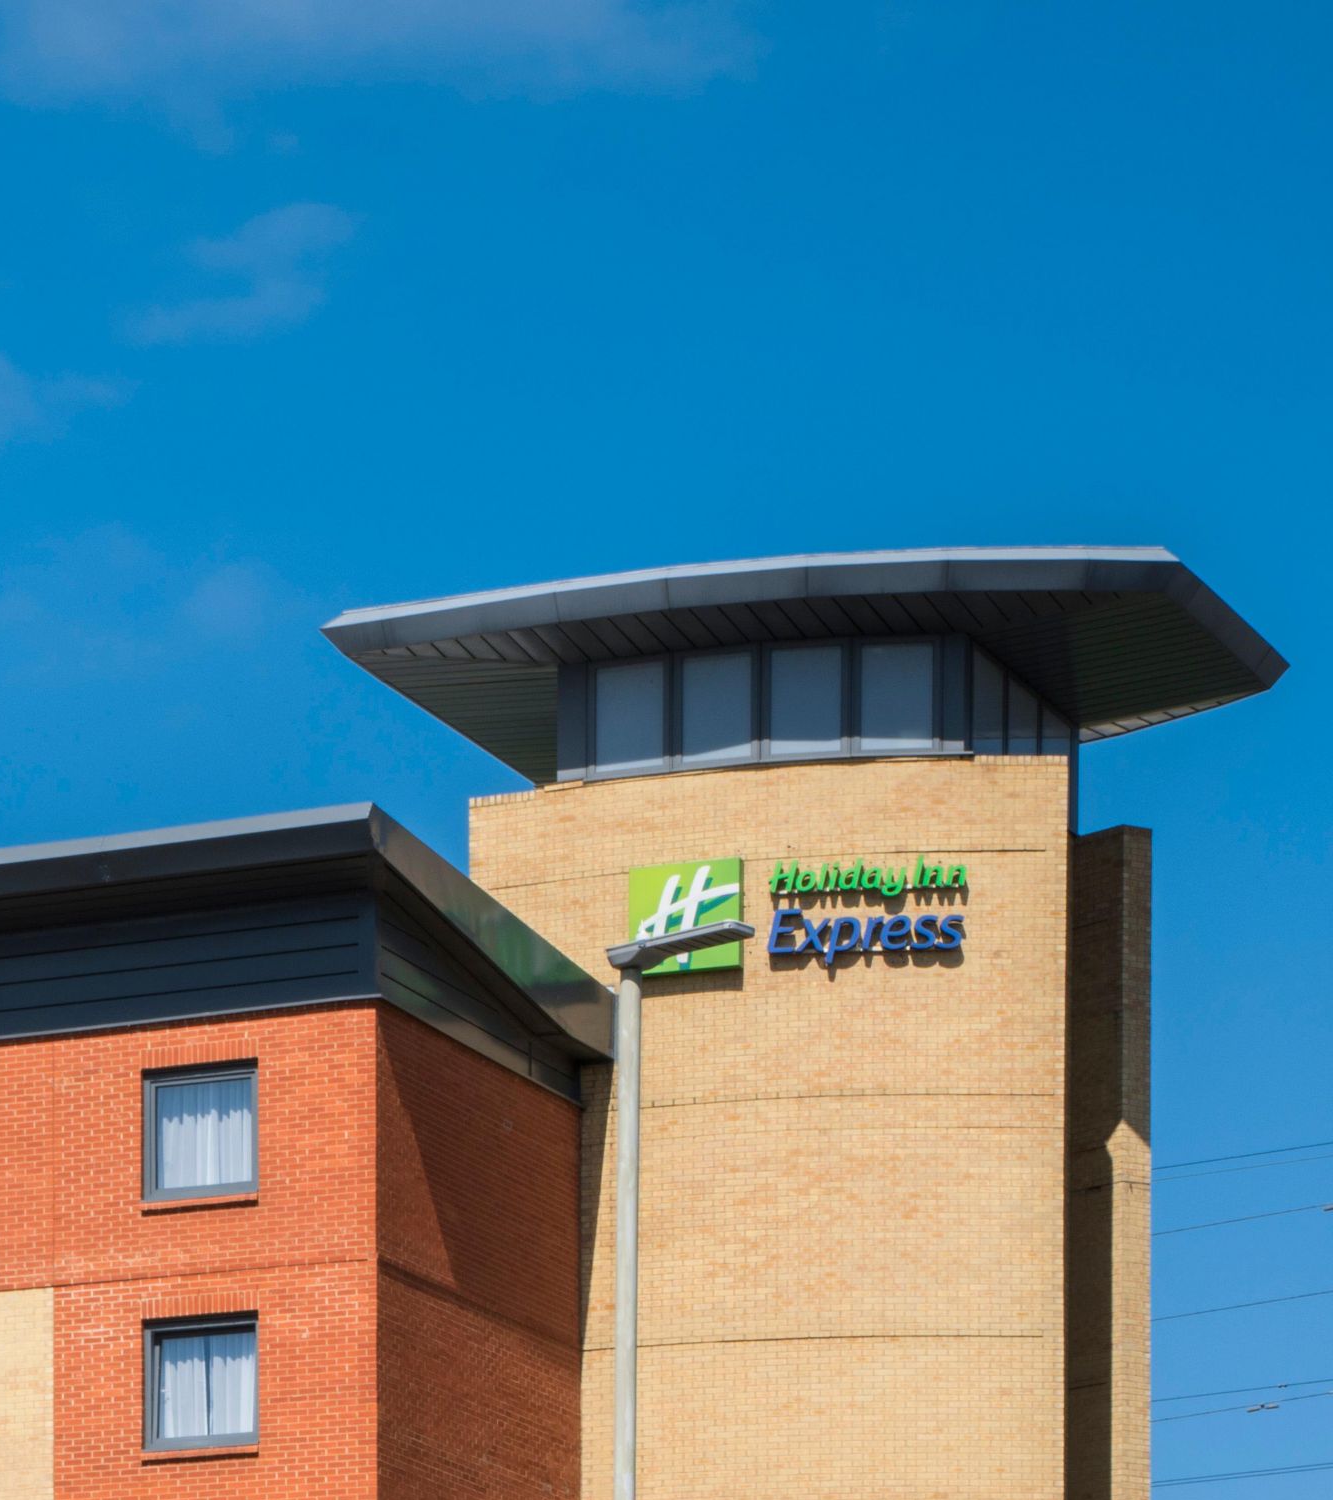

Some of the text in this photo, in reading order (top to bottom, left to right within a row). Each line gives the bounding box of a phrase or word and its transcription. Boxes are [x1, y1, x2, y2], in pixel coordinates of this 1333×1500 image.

[769, 854, 967, 896] Holiday Inn
[767, 908, 966, 965] Express
